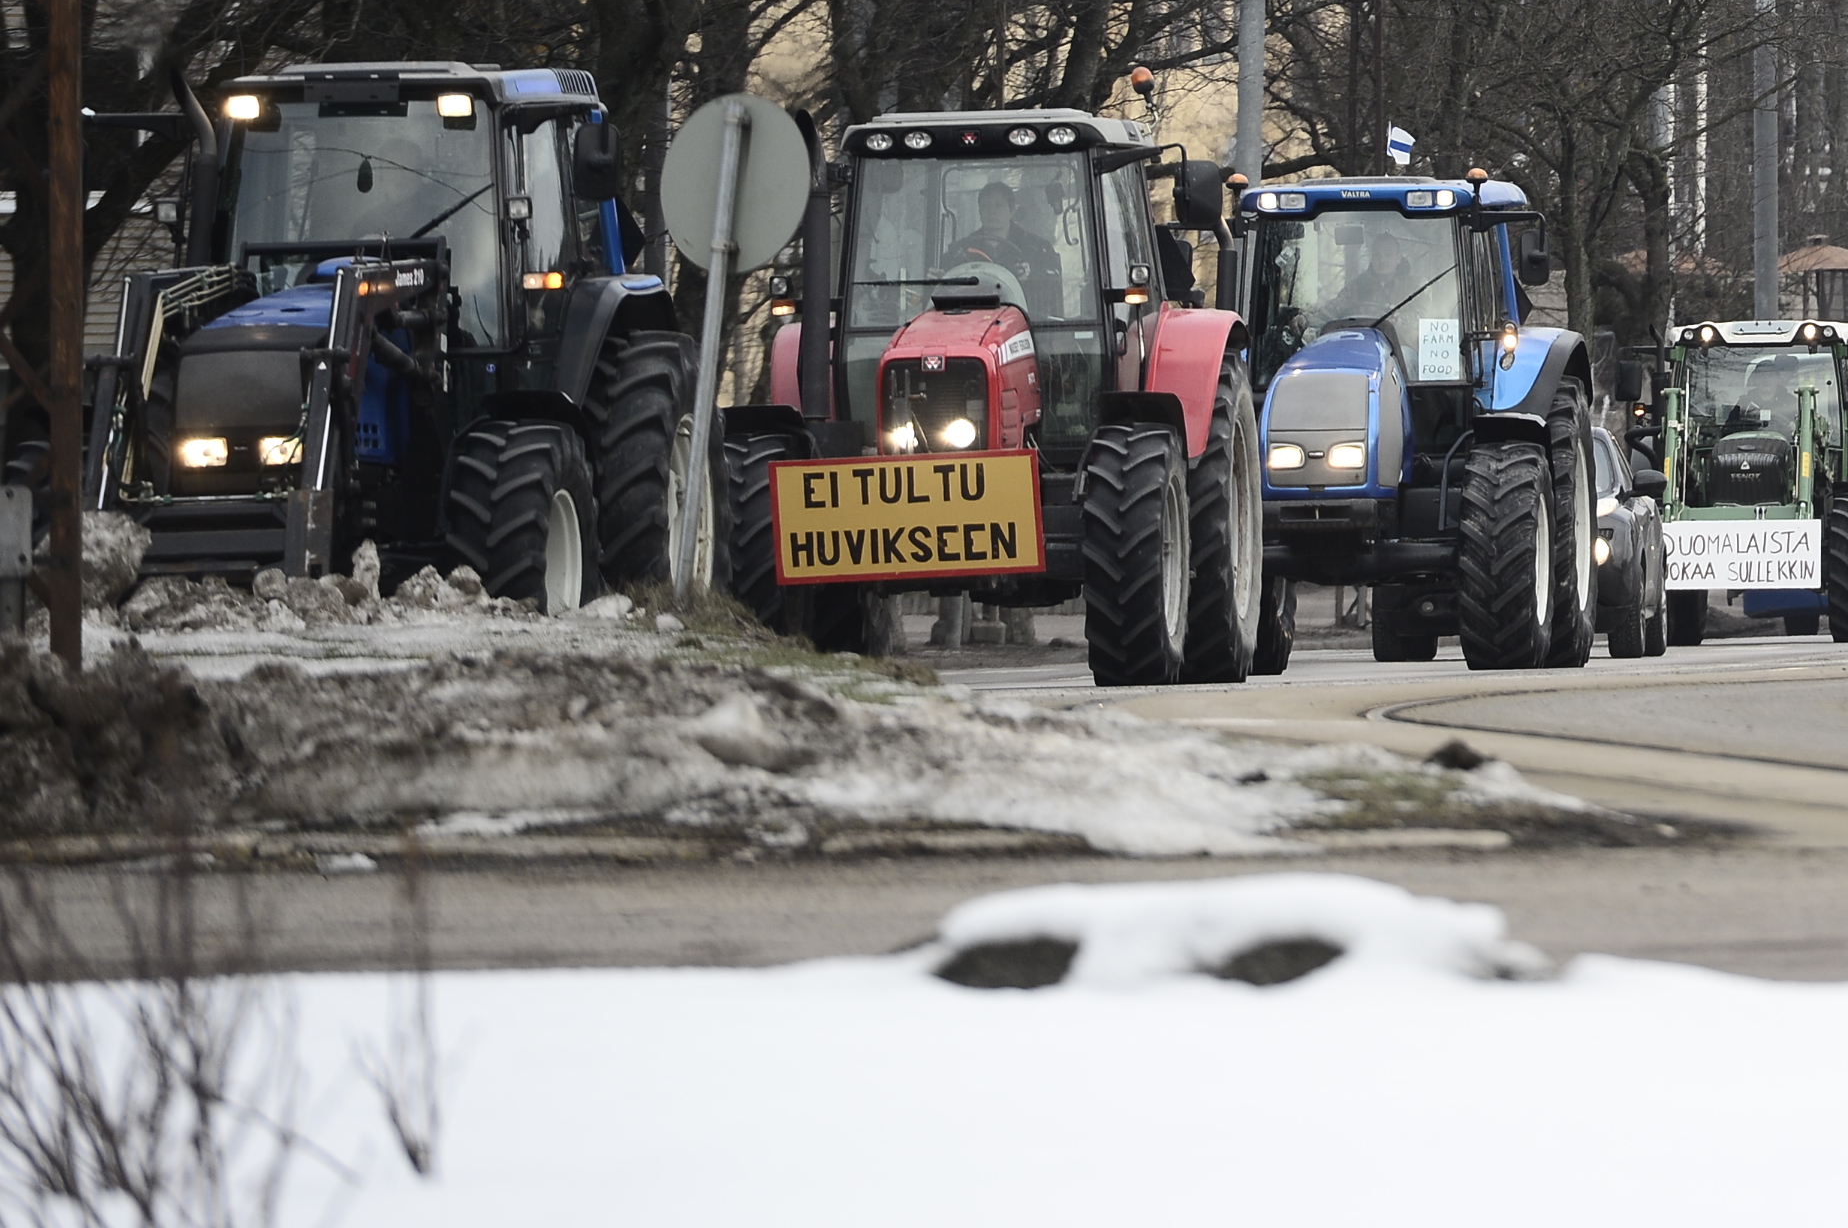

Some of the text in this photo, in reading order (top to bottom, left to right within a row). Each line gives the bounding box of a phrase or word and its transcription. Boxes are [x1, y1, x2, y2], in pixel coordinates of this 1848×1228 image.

[1430, 321, 1449, 333] NO
[1423, 334, 1454, 344] FARM
[1430, 350, 1450, 359] NO
[1422, 364, 1453, 375] FOOD
[803, 471, 839, 509] EI
[790, 522, 1018, 568] HUVIKSEEN
[1727, 559, 1815, 583] SULLEKKIN
